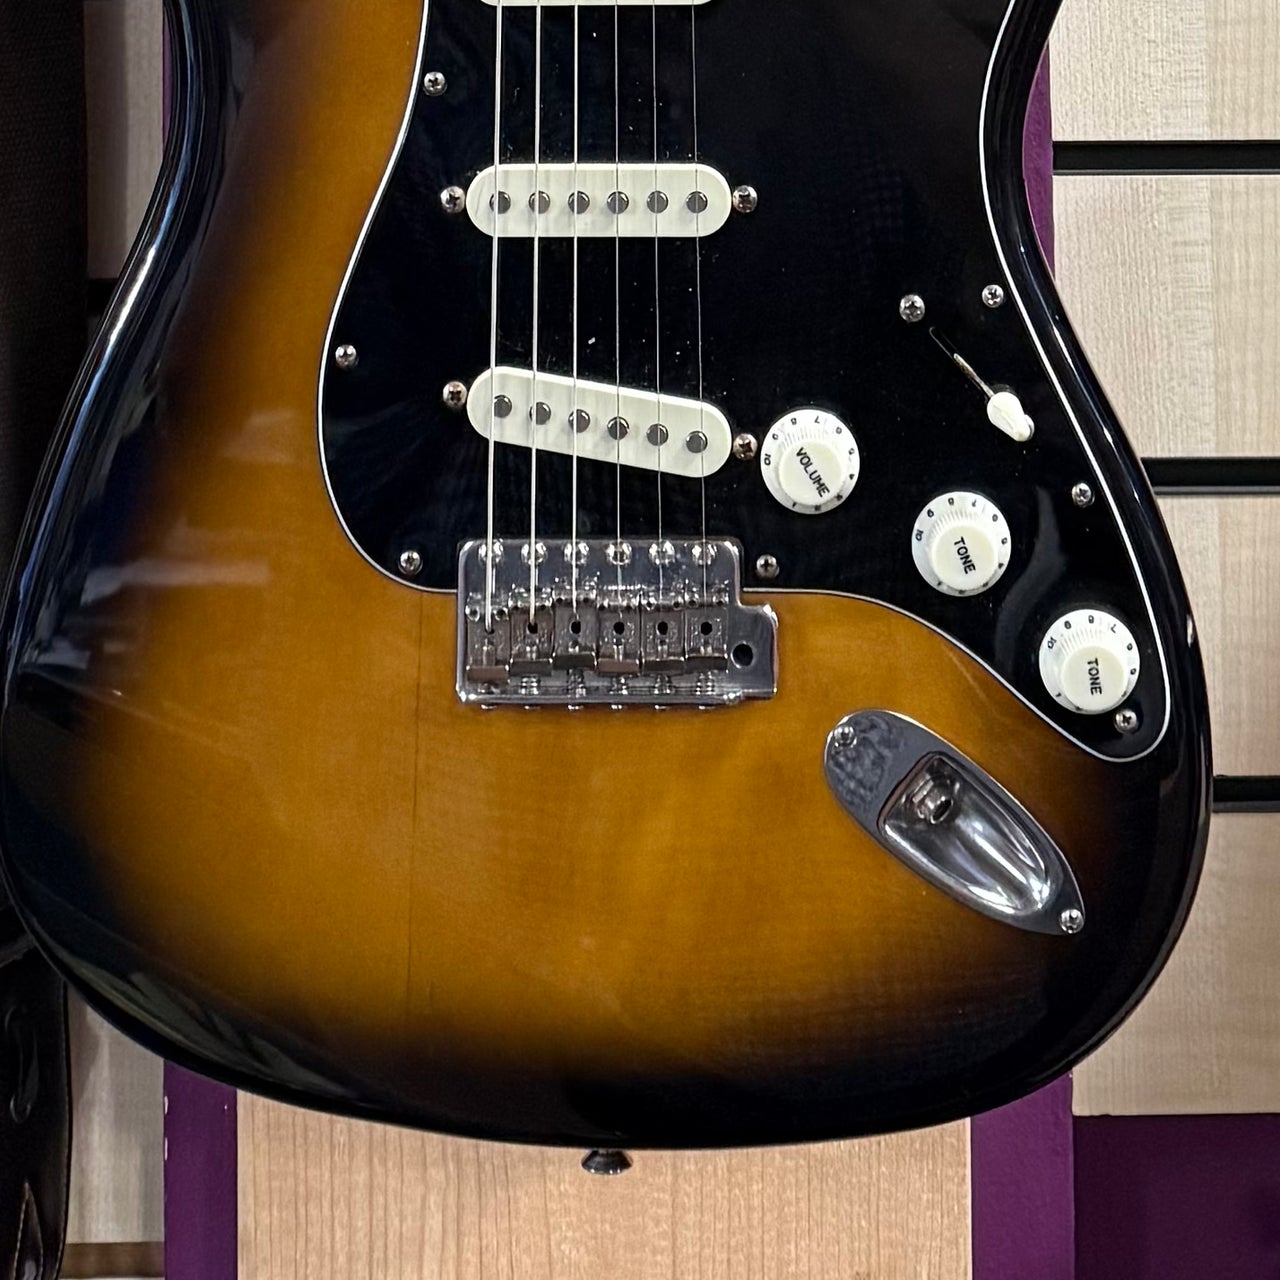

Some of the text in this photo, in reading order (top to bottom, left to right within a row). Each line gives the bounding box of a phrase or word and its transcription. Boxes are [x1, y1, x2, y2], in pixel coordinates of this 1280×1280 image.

[795, 447, 830, 498] VOLUME
[953, 536, 976, 575] TONE
[1086, 657, 1102, 696] TONE
